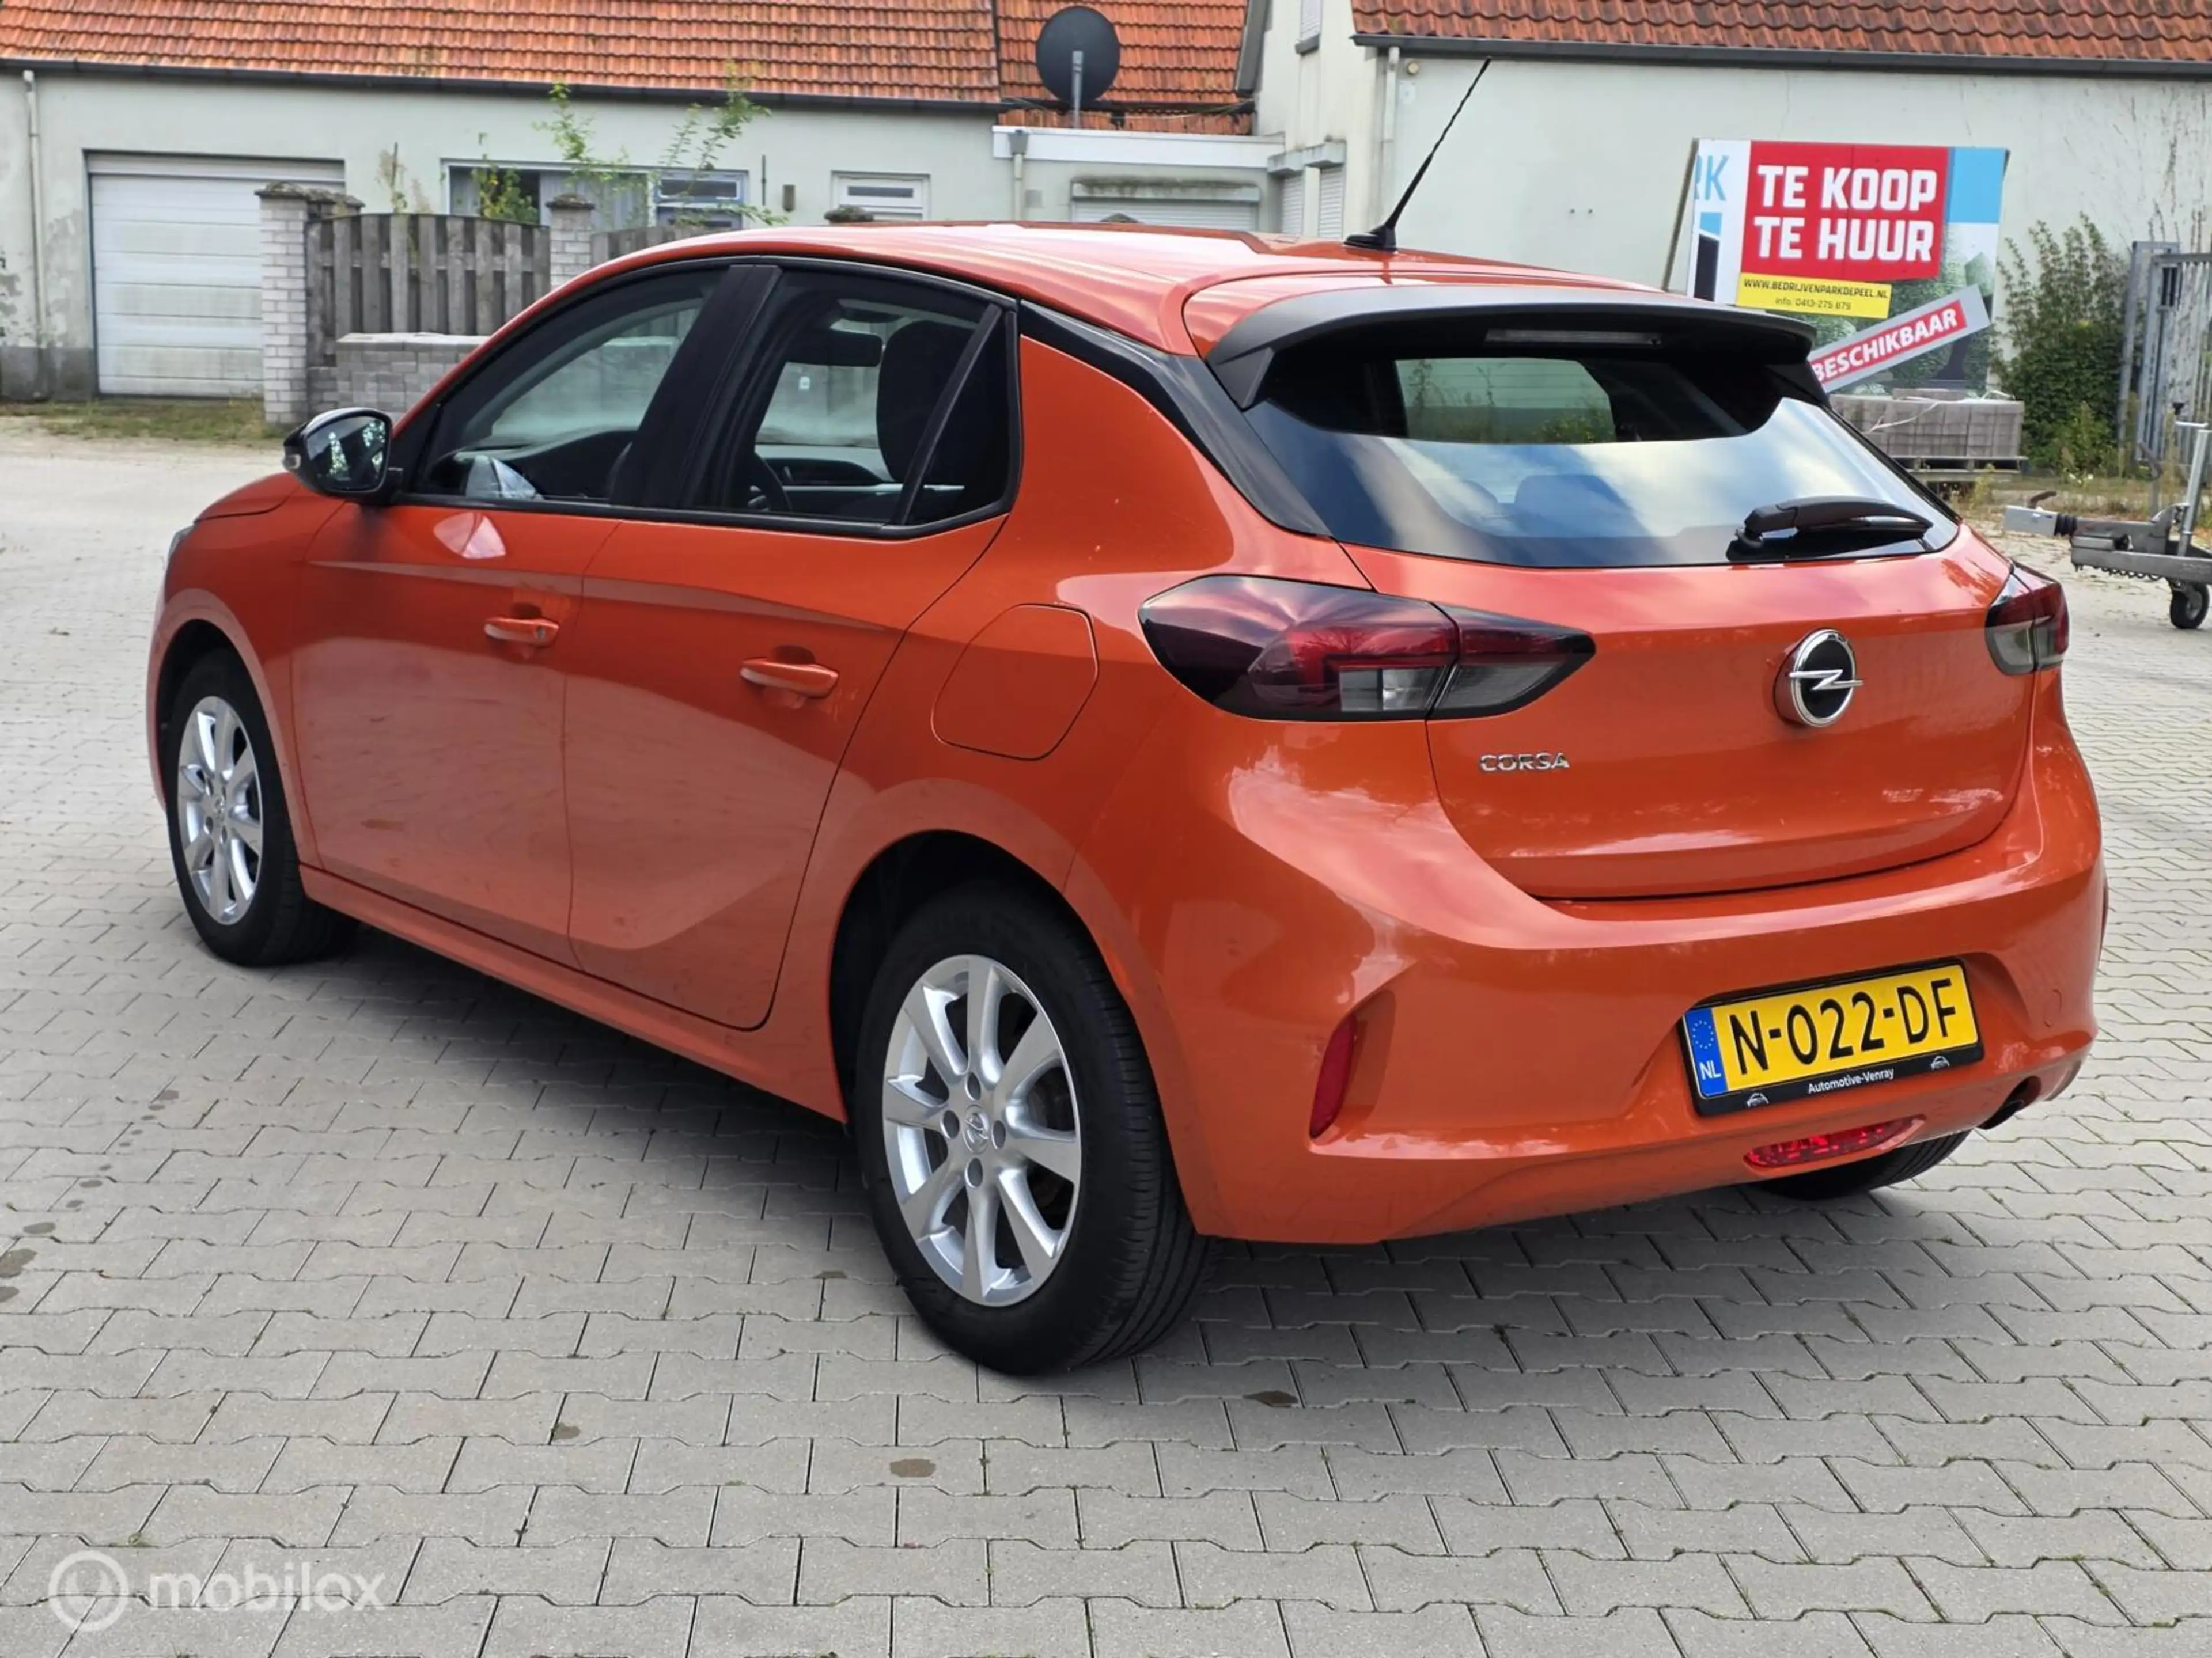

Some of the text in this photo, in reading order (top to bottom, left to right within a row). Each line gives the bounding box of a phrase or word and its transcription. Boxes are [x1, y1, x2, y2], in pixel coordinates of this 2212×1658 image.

[1757, 165, 1937, 211] TE KOOP
[1754, 216, 1935, 262] TE HUUR
[1812, 308, 1957, 381] BESCHIKBAAR
[1480, 752, 1570, 772] CORSA
[1729, 978, 1956, 1075] N-022-DF
[1700, 1058, 1722, 1080] NL
[1808, 1068, 1895, 1094] Automotive-Venray
